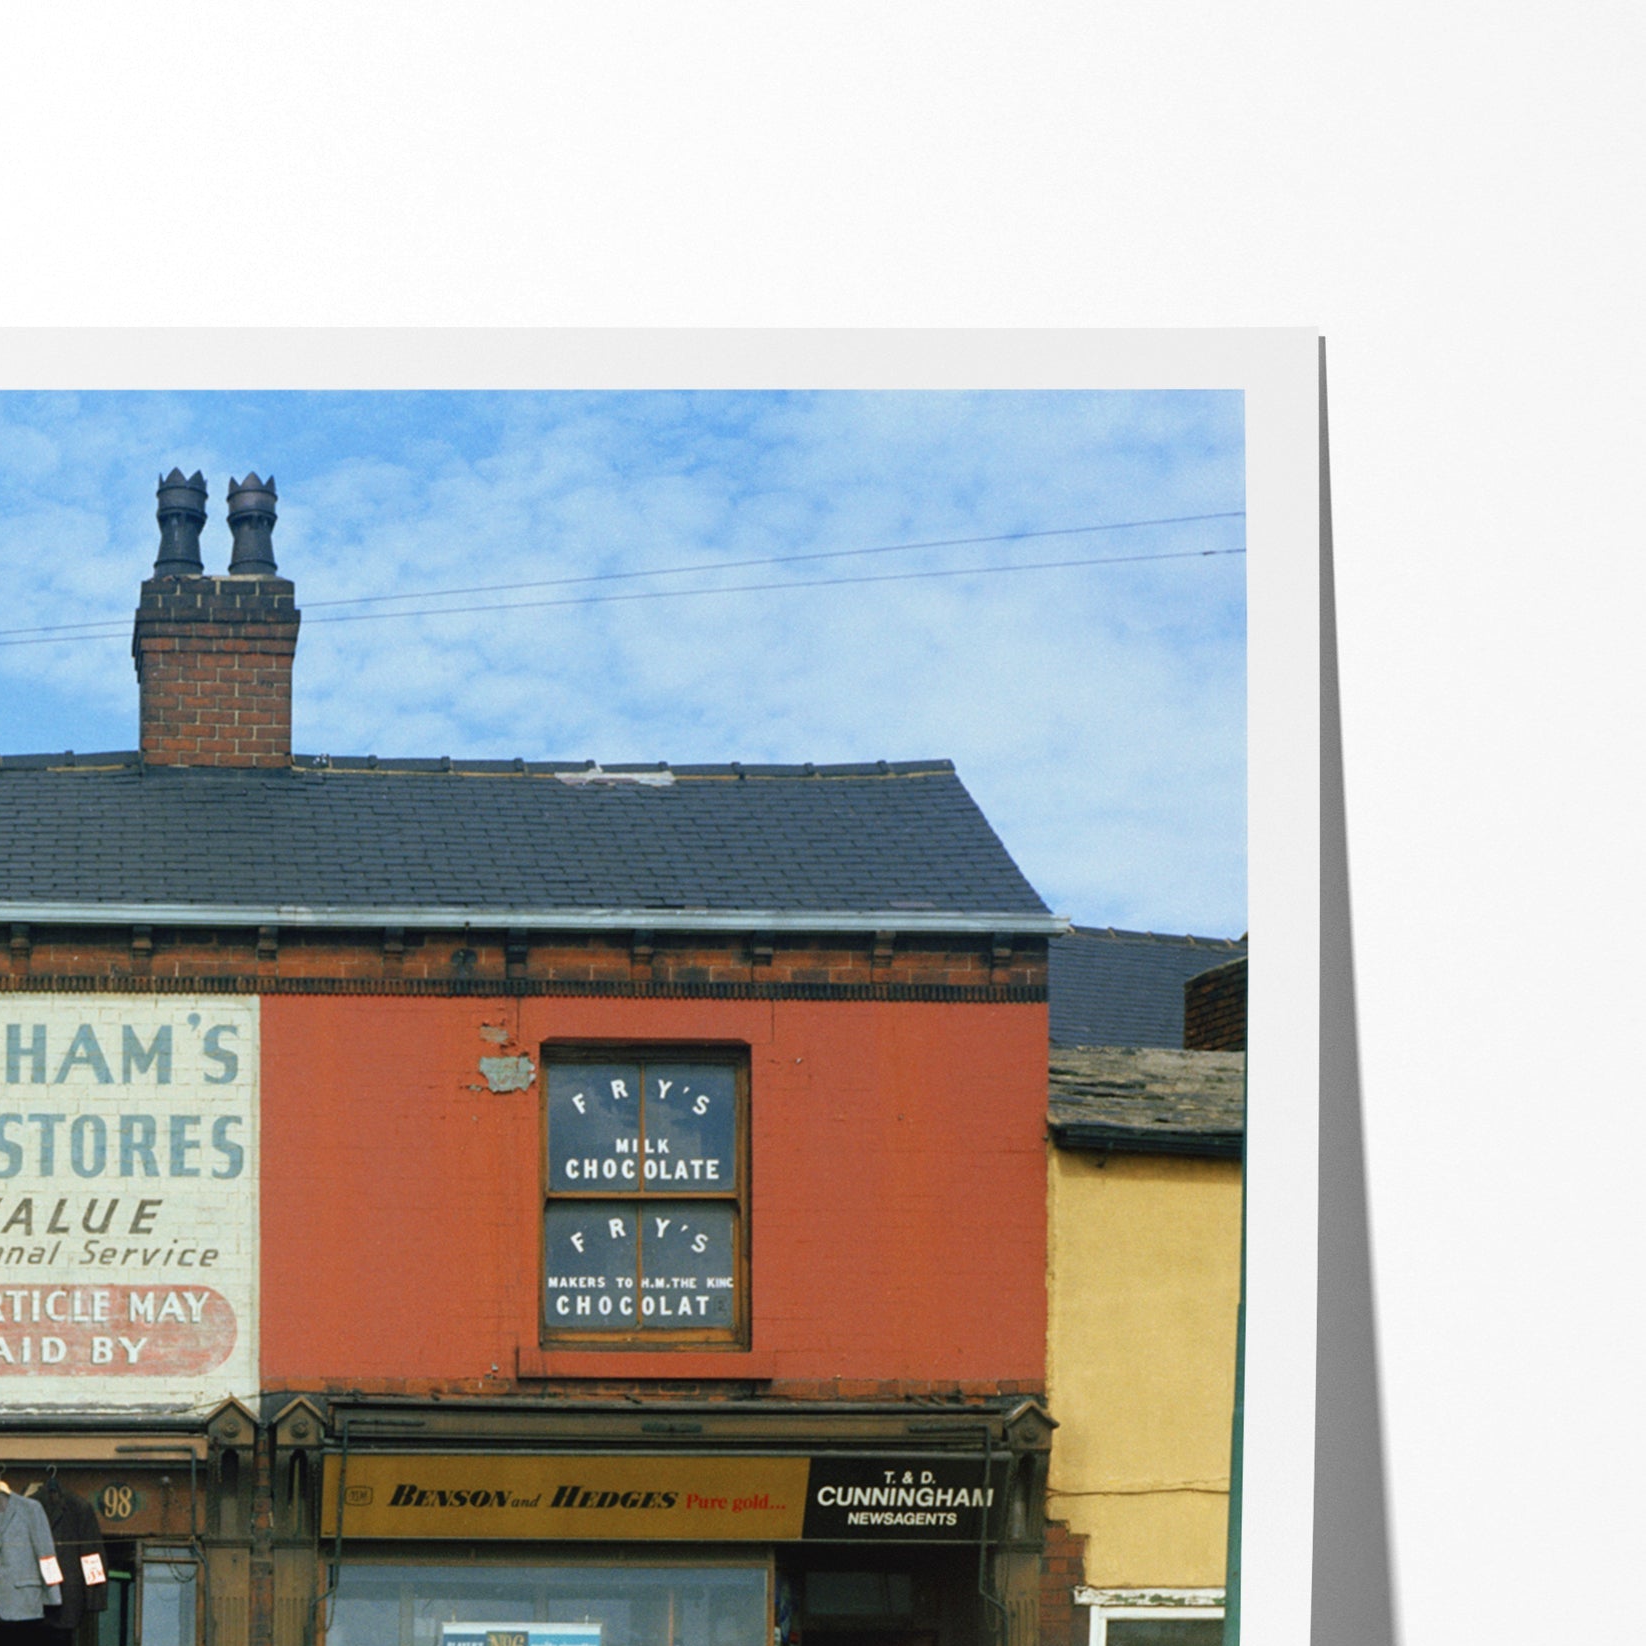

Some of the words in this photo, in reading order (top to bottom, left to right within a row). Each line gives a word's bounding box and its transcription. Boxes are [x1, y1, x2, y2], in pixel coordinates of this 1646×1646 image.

[571, 1079, 710, 1116] FRY'S
[615, 1138, 671, 1154] MILK
[565, 1159, 721, 1180] CHOCOLATE
[569, 1217, 710, 1253] FRY'S
[78, 1240, 220, 1269] Service
[548, 1277, 607, 1289] MAKERS
[616, 1277, 634, 1289] TO
[128, 1291, 210, 1323] MAY
[556, 1295, 710, 1316] CHOCOLAT
[90, 1337, 149, 1365] BY
[884, 1471, 897, 1484] T.
[902, 1471, 914, 1484] &
[920, 1471, 937, 1484] D.
[104, 1486, 132, 1518] 98
[387, 1484, 510, 1508] BENSON
[511, 1494, 545, 1508] and
[551, 1485, 679, 1509] HEDGES
[685, 1493, 729, 1510] Pure
[817, 1486, 995, 1507] CUNNINGHAM
[847, 1512, 958, 1526] NEWSAGENTS
